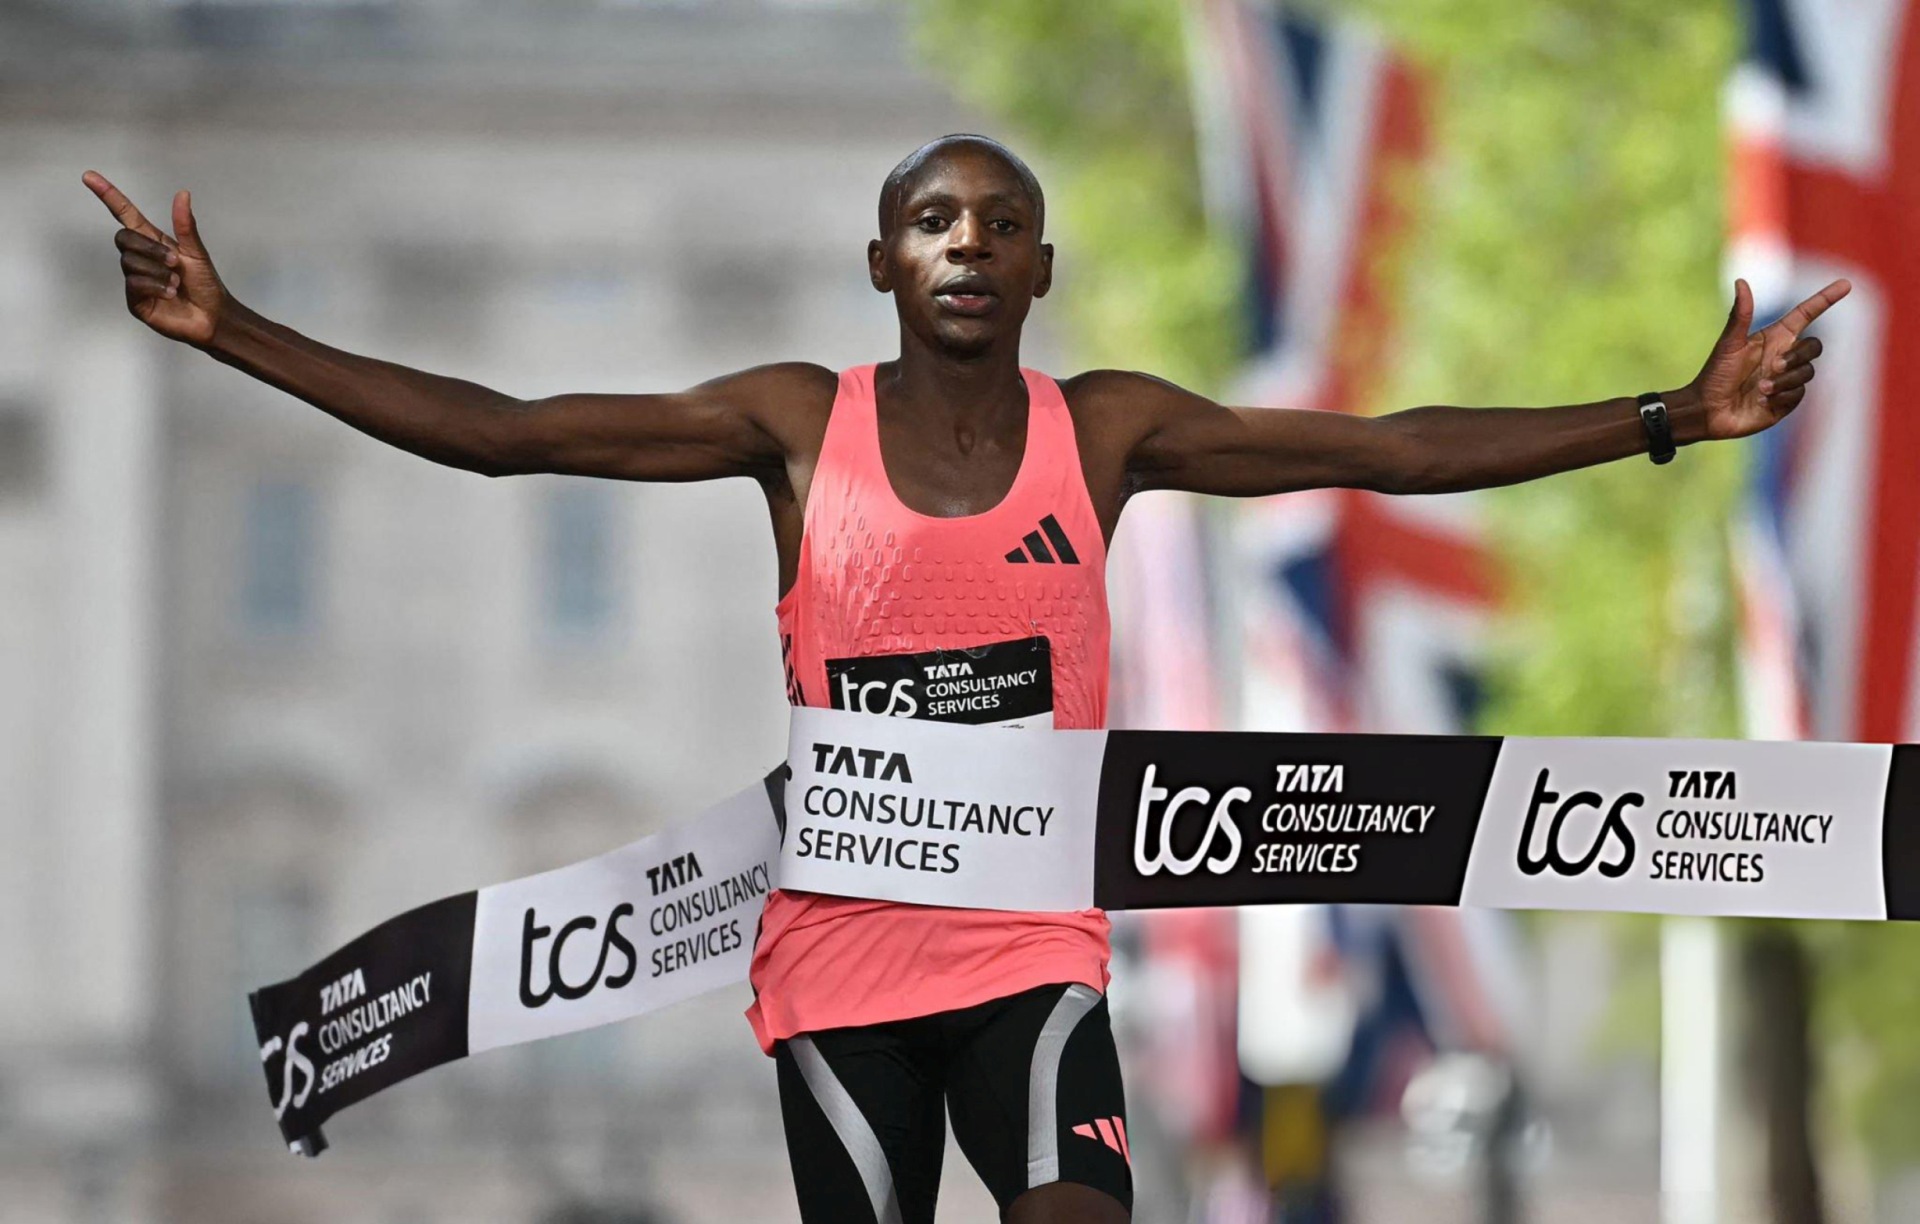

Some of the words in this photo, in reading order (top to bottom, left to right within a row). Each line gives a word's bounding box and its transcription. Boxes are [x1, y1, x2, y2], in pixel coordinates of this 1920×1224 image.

[923, 662, 973, 680] TATA
[925, 669, 1038, 699] CONSULTANCY
[840, 672, 918, 718] tcs
[927, 694, 1001, 716] SERVICES
[812, 742, 913, 784] TATA
[1276, 764, 1344, 793] TATA
[1668, 770, 1736, 800] TATA
[803, 785, 1054, 836] CONSULTANCY
[1133, 763, 1252, 877] tcs
[1261, 803, 1436, 834] CONSULTANCY
[1516, 767, 1645, 878] tcs
[1656, 809, 1833, 844] CONSULTANCY
[795, 827, 960, 874] SERVICES
[1251, 843, 1361, 873] SERVICES
[1649, 850, 1765, 883] SERVICES
[646, 852, 703, 896] TATA
[649, 861, 773, 936] CONSULTANCY
[519, 902, 637, 1009] tcs
[651, 919, 742, 978] SERVICES
[318, 971, 431, 1055] CONSULTANCY
[319, 968, 366, 1016] TATA
[318, 1033, 393, 1093] SERVICES
